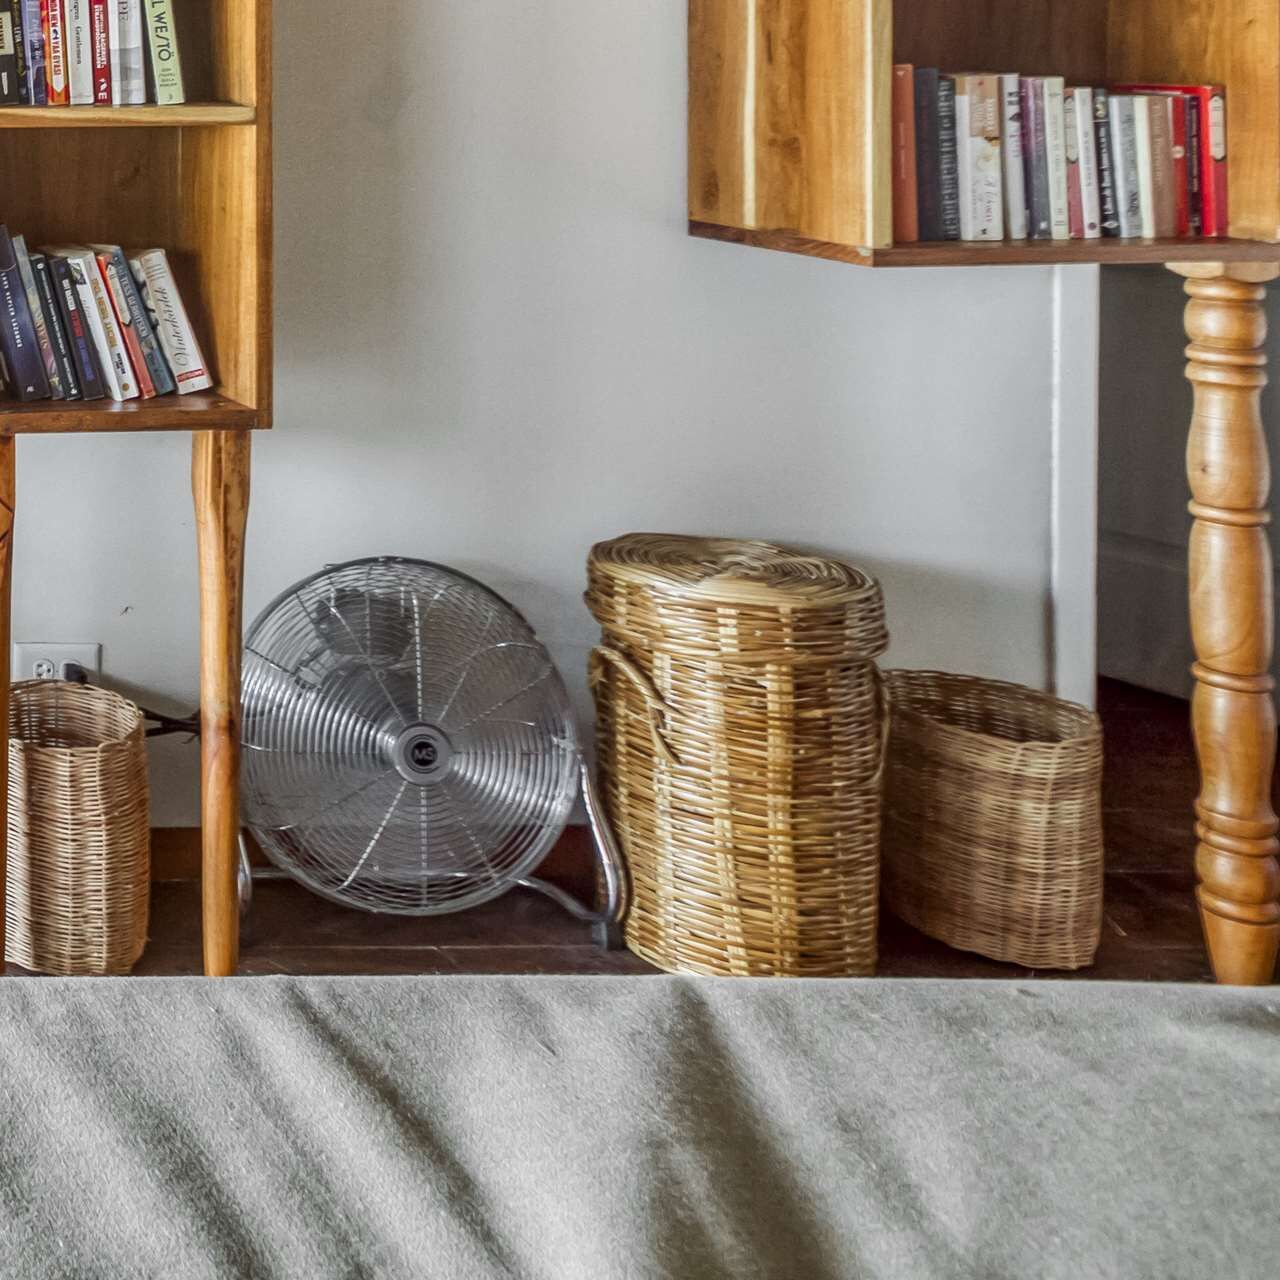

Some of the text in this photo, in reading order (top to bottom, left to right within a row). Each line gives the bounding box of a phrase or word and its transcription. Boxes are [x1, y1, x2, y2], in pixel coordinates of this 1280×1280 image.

[50, 13, 59, 27] HEM
[153, 11, 175, 61] WESTÖ
[51, 40, 62, 75] YAA GYASI
[75, 26, 83, 64] Gentlemen
